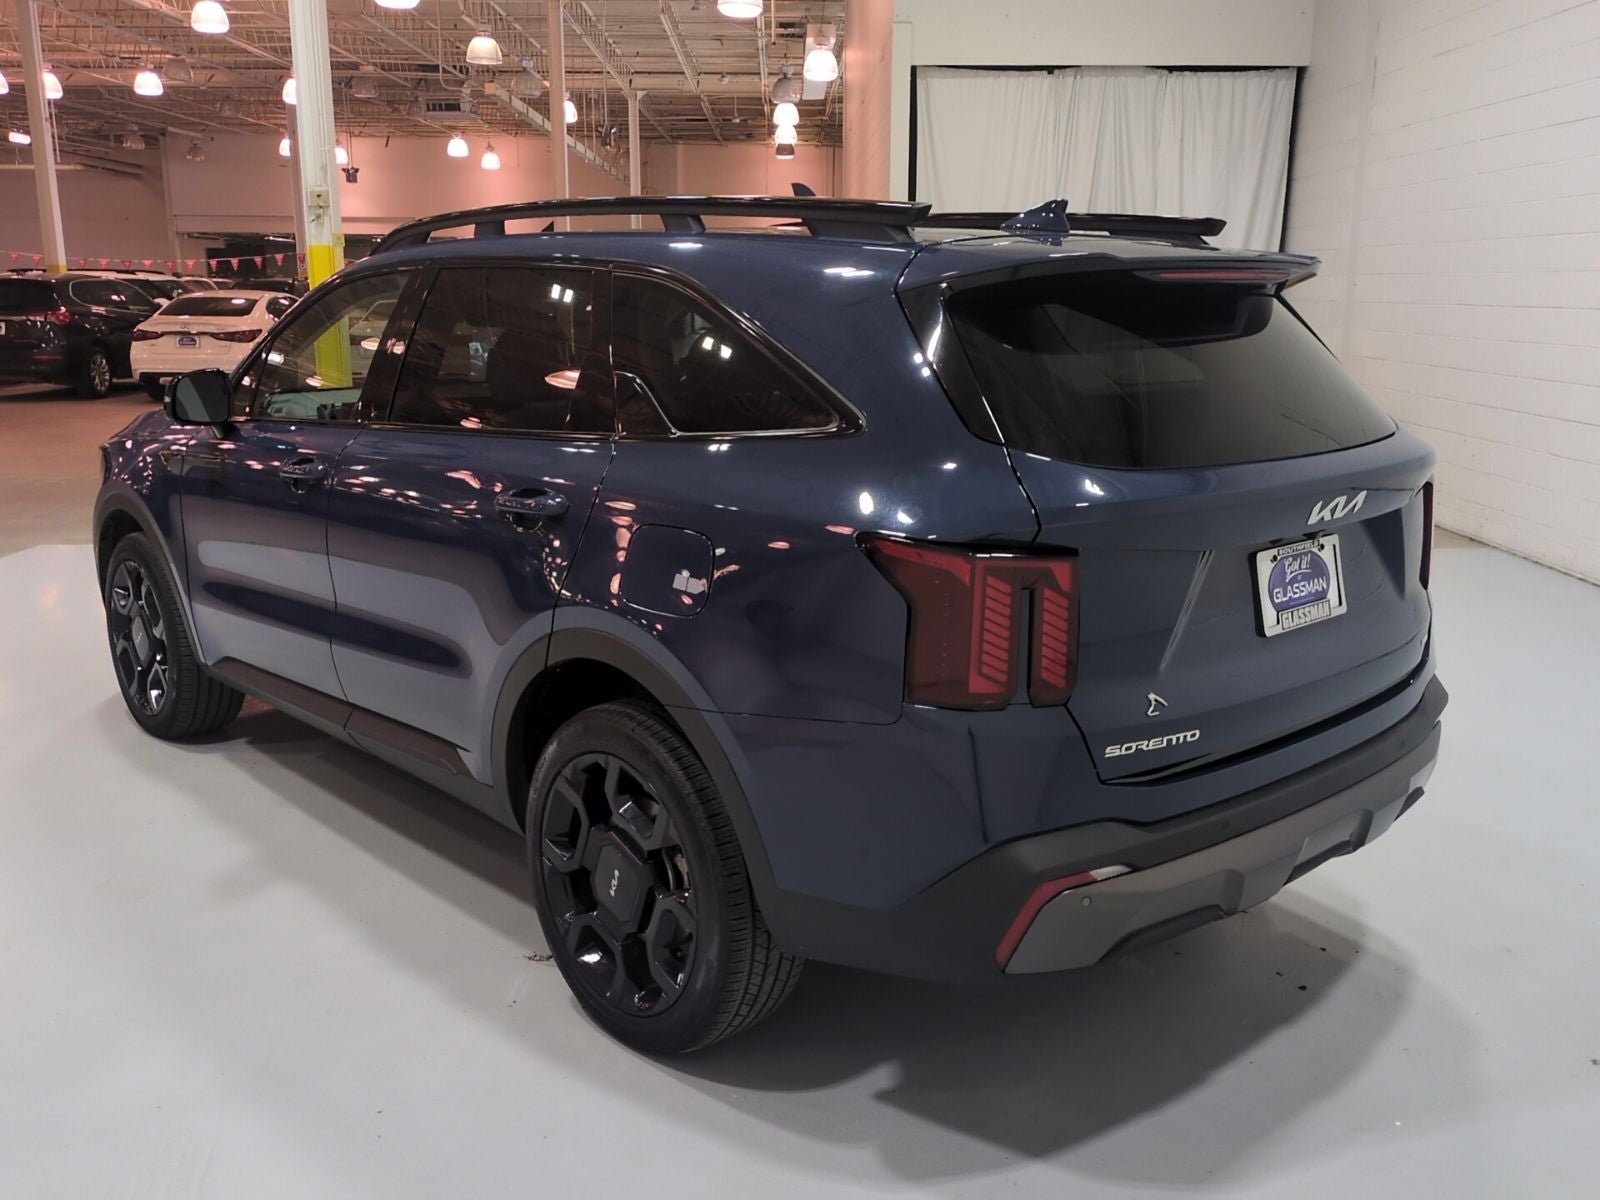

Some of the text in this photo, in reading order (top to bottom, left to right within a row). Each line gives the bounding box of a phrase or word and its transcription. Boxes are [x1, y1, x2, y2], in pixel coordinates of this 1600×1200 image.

[1284, 556, 1300, 576] Got
[1273, 576, 1327, 603] GLASSMAN
[1281, 601, 1330, 629] GLASSMAN
[1104, 729, 1200, 758] SORENTO
